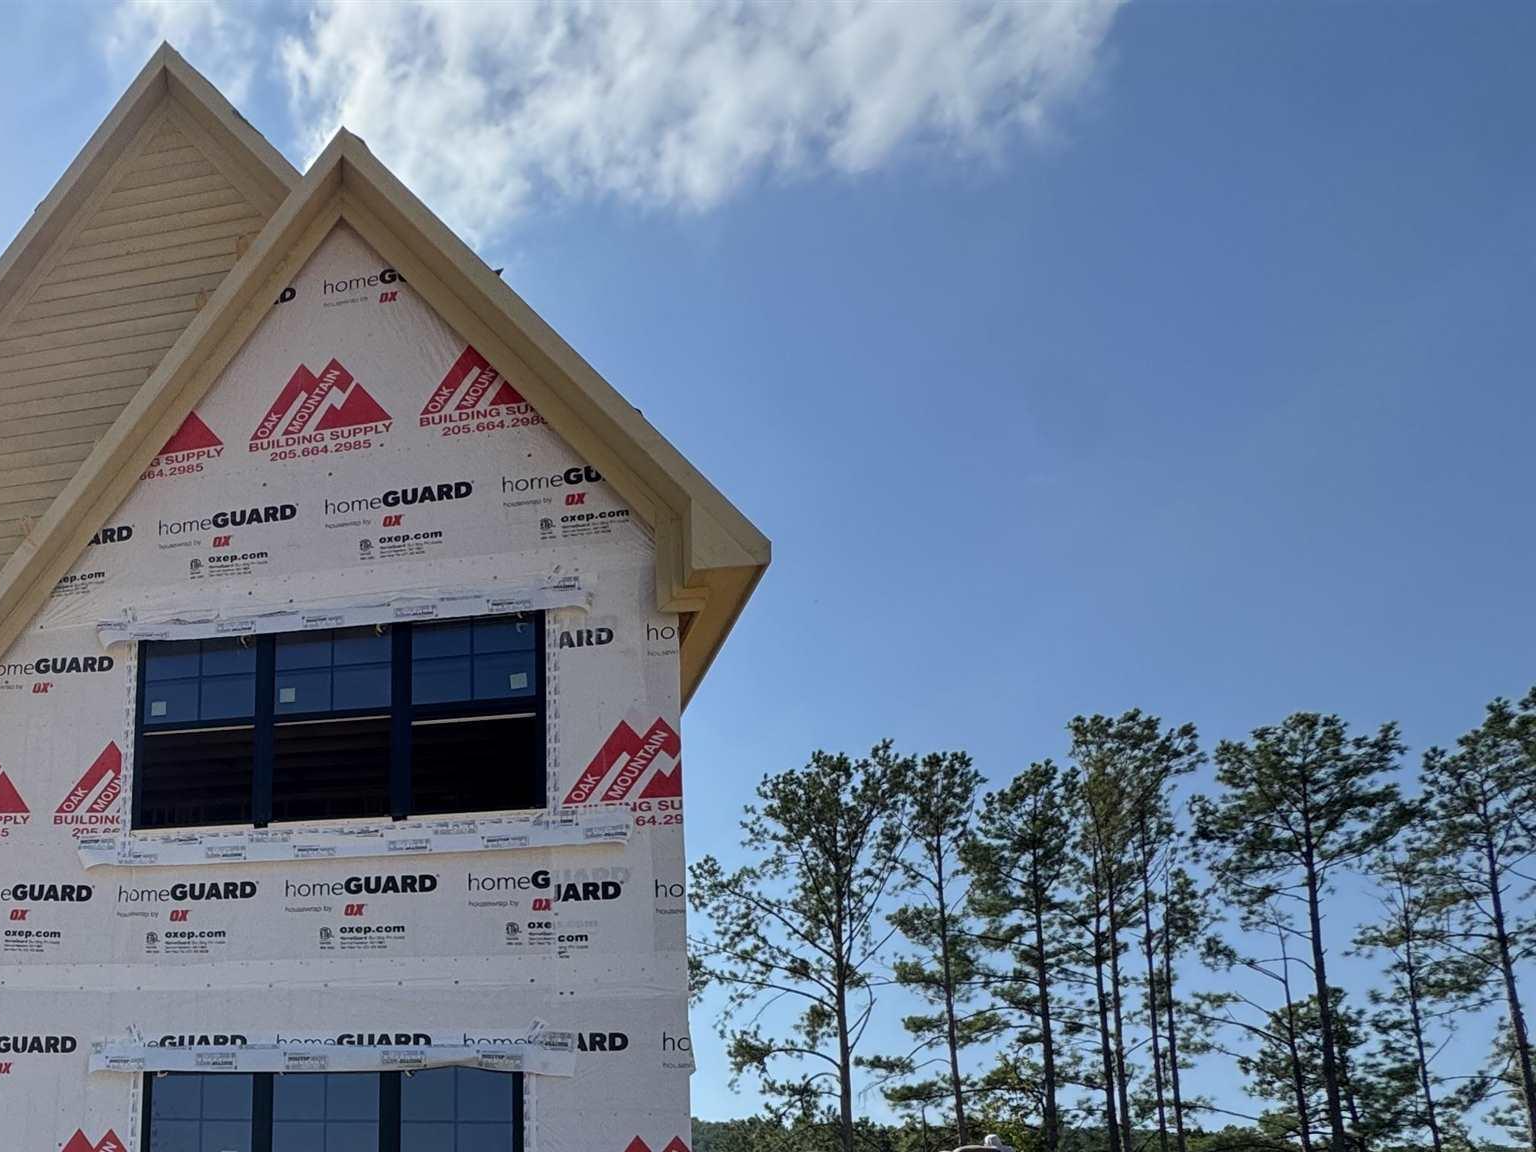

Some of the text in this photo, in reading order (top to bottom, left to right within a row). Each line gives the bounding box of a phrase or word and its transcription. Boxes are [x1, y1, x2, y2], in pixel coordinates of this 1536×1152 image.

[463, 366, 497, 408] MOUN
[290, 369, 340, 433] MOUNTAIN
[428, 386, 455, 413] OAK
[258, 411, 283, 439] OAK
[419, 407, 500, 428] BUILDING
[249, 422, 393, 453] BUILDING SUPPLY
[165, 447, 224, 466] SUPPLY
[269, 439, 372, 462] 205.664.2985
[502, 465, 607, 494] homeGU
[325, 481, 473, 516] homeGUARD
[564, 493, 586, 506] OX
[159, 504, 297, 537] homeGUARD
[382, 514, 403, 527] OX
[560, 508, 630, 525] oxep.com
[212, 535, 232, 548] OX
[379, 530, 443, 545] oxep.com
[208, 550, 269, 565] oxep.com
[32, 682, 51, 694] OX
[608, 730, 669, 799] MOUNTAIN
[571, 773, 601, 801] OAK
[63, 786, 89, 812] OAK
[118, 881, 257, 902] homeGUARD
[285, 875, 437, 897] homeGUARD
[10, 909, 30, 921] OX
[344, 904, 366, 916] OX
[532, 899, 552, 911] OX
[170, 910, 190, 921] OX
[4, 929, 61, 940] oxep.com
[164, 929, 226, 939] oxep.com
[339, 924, 405, 936] oxep.com
